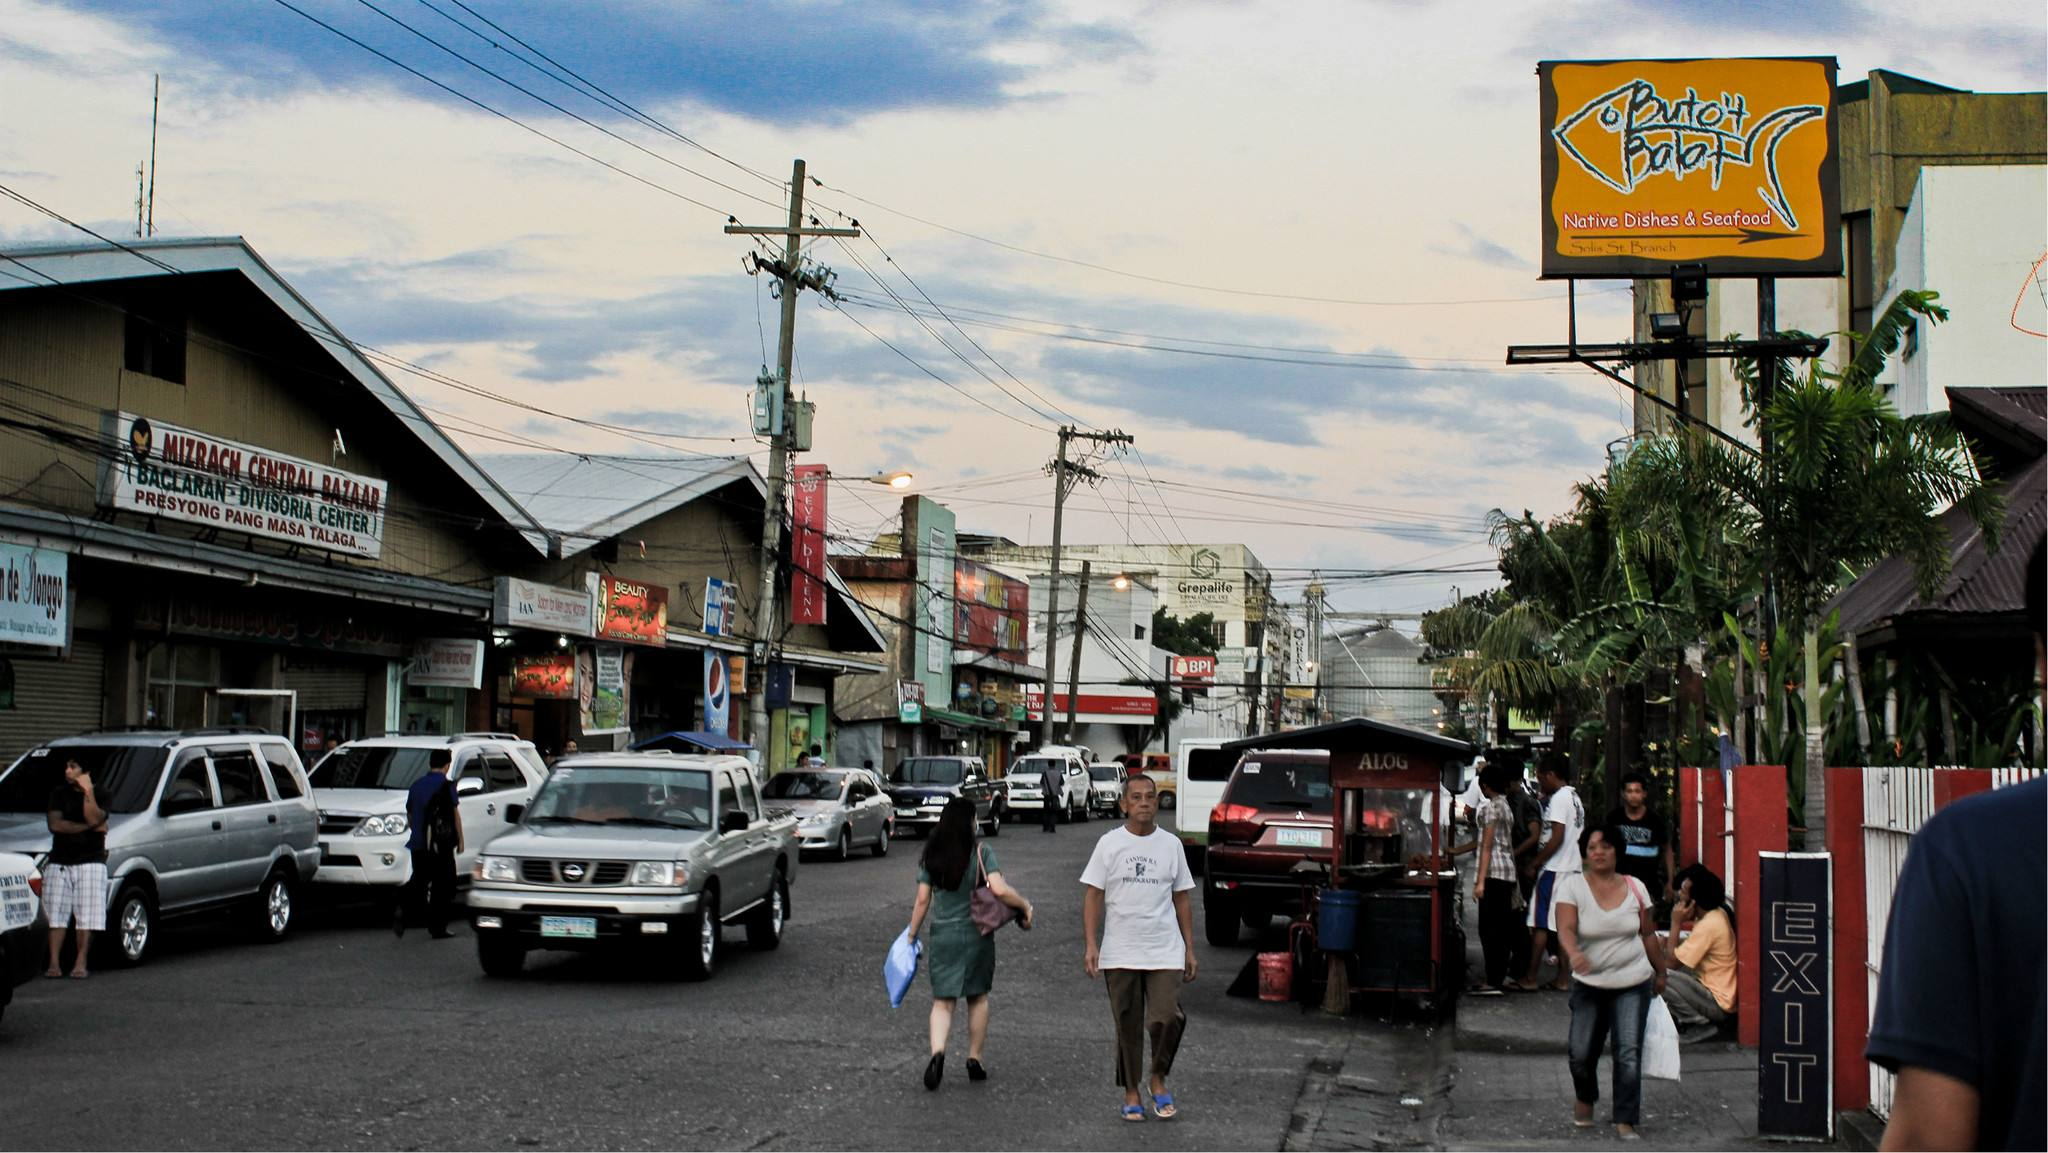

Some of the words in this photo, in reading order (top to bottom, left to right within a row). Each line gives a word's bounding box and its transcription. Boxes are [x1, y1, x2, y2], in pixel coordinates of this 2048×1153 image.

[1563, 211, 1619, 229] Native
[1624, 210, 1679, 228] Dishes
[1684, 210, 1697, 227] &
[1702, 209, 1772, 227] Seafood
[1630, 240, 1677, 255] Branch
[162, 432, 242, 480] MIZRACH
[248, 455, 315, 499] CENTRAL
[321, 474, 380, 514] BAZAAR
[135, 488, 221, 520] PRESYONG
[225, 508, 264, 529] PANG
[267, 517, 306, 538] MASA
[239, 484, 313, 522] DIVISORIA
[7, 557, 19, 603] de
[614, 580, 648, 598] BEAUTY
[1177, 581, 1233, 595] Grepalife
[1189, 660, 1211, 673] BPI
[1769, 901, 1821, 1104] EXIT
